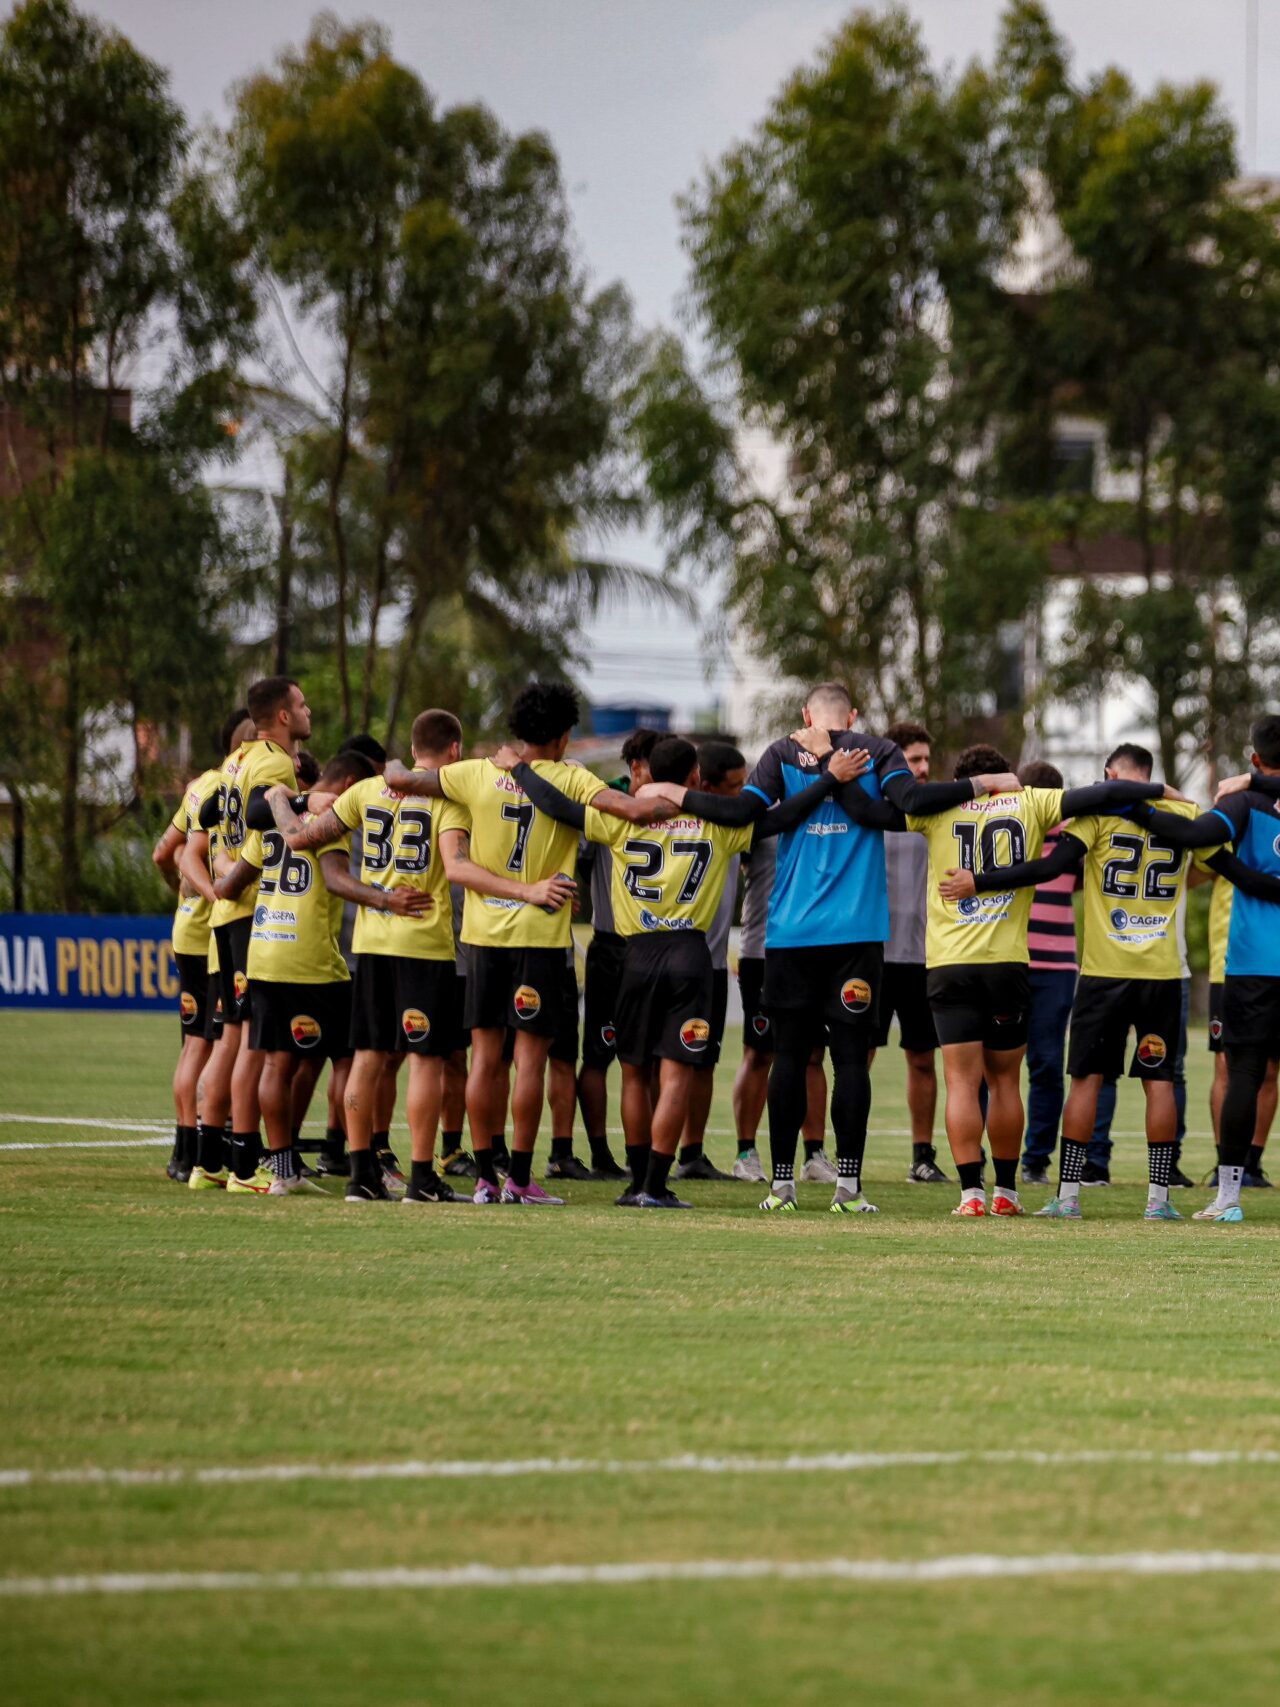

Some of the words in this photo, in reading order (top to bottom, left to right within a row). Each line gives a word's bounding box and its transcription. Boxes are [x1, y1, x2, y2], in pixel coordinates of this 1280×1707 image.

[260, 829, 312, 896] 26
[363, 805, 432, 874] 33
[501, 802, 535, 872] 7
[952, 815, 1026, 876] 10
[1102, 832, 1183, 900] 22
[623, 838, 713, 904] 27
